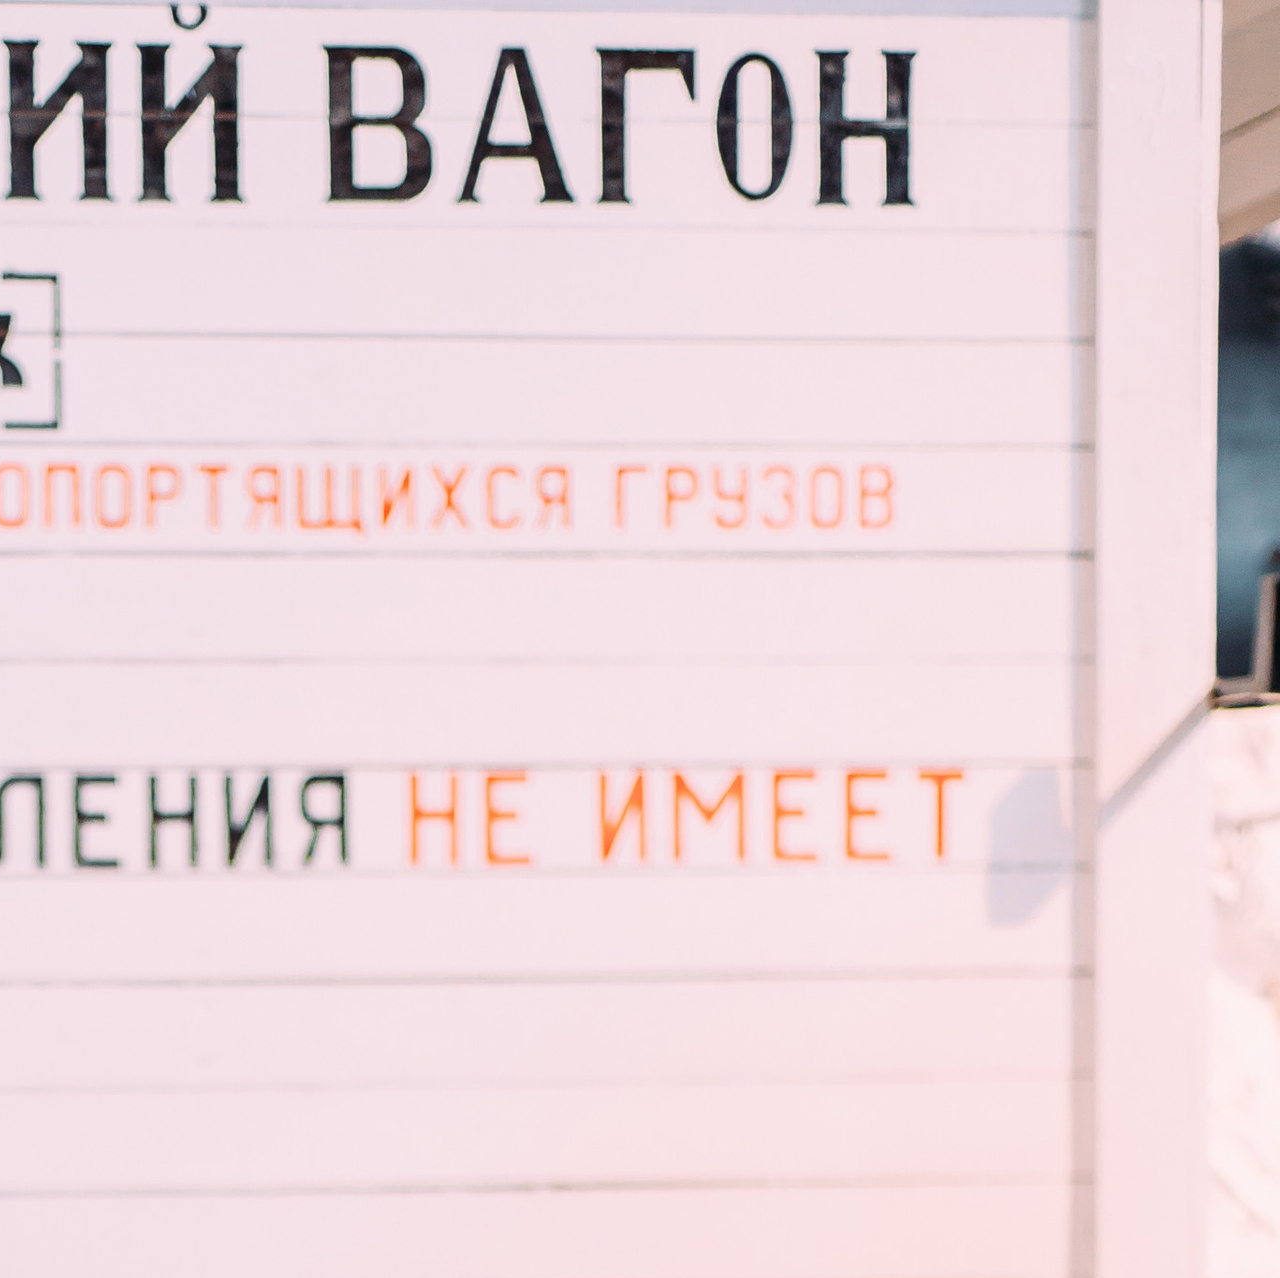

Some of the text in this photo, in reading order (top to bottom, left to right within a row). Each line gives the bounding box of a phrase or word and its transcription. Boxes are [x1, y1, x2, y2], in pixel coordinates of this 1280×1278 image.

[322, 44, 918, 207] ВАГОН
[614, 467, 894, 528] ГРУЗОВ
[410, 773, 530, 864] НЕ
[599, 770, 964, 862] ИМЕЕТ
